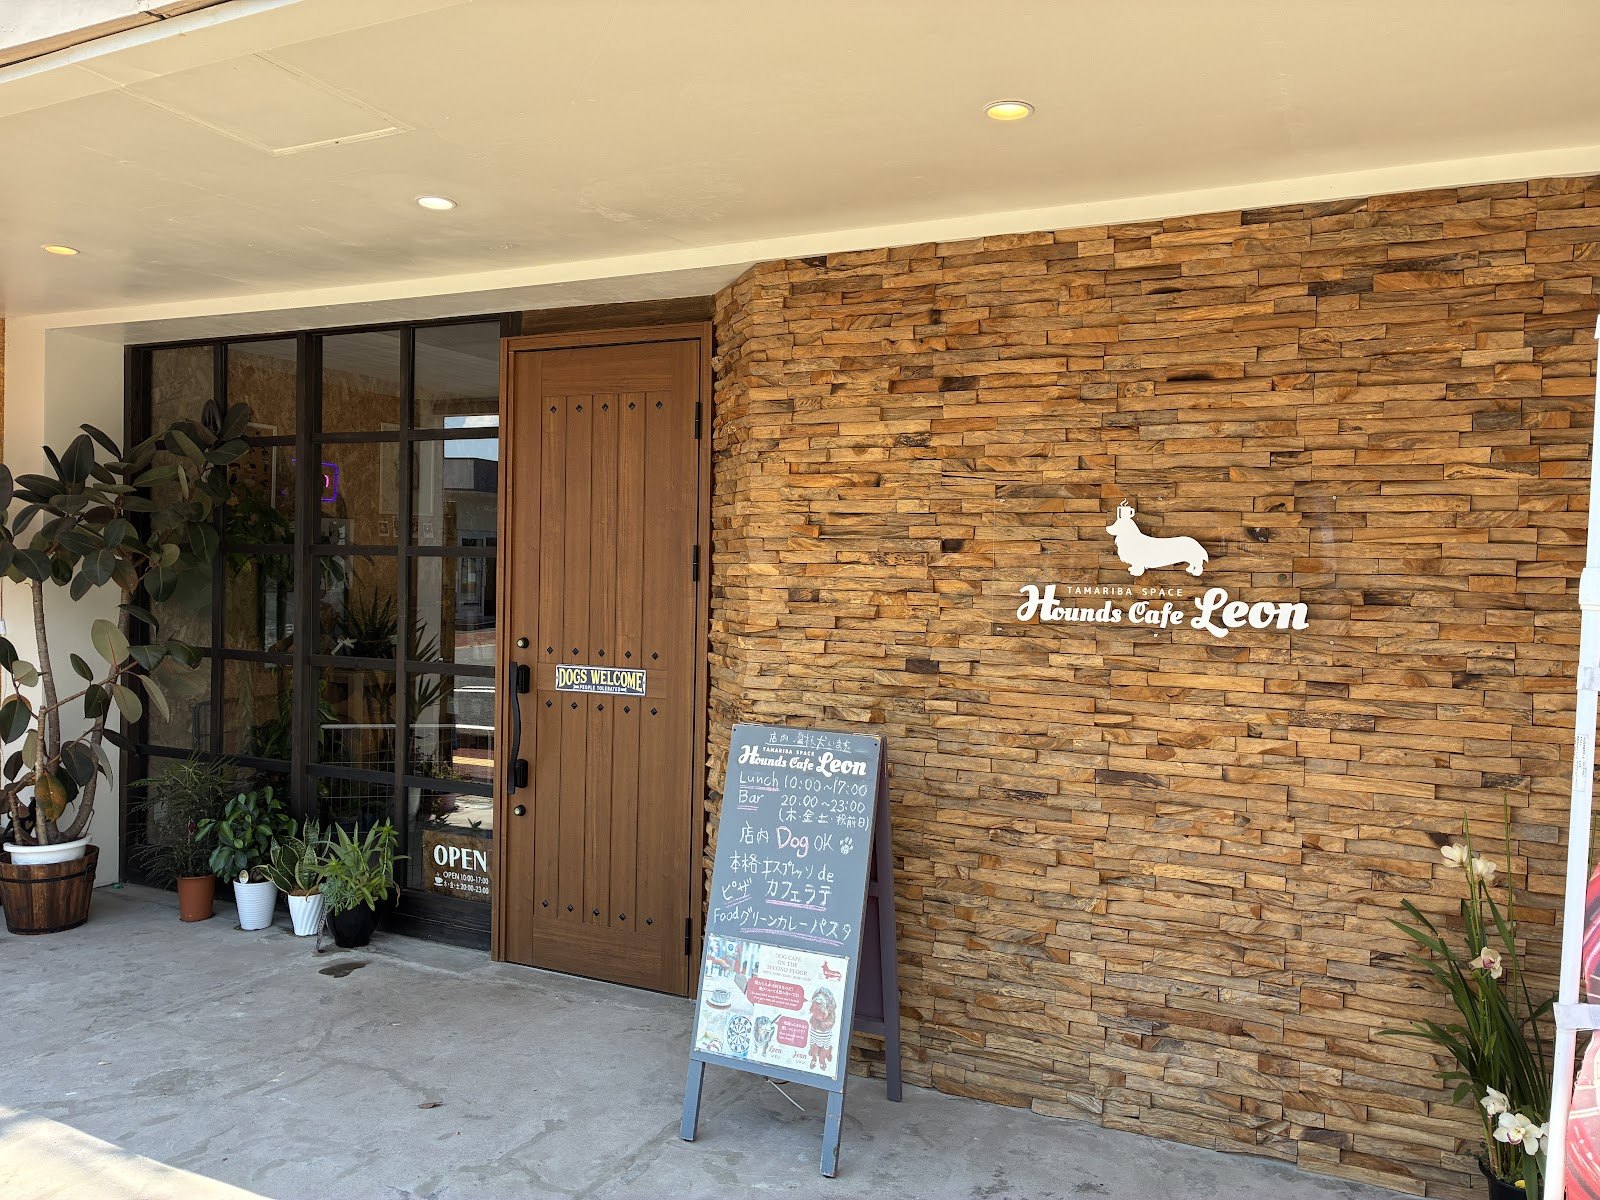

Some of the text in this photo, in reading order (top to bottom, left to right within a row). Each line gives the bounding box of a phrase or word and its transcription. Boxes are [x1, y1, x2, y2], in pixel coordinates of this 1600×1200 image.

[1066, 586, 1184, 597] TAMARIBA SPACE
[1016, 584, 1309, 638] Hounds Cafe Leon
[559, 668, 643, 692] DOGS WELCOME
[768, 731, 789, 743] 店内
[762, 746, 815, 757] TAMARIBA SPACE
[738, 745, 867, 777] Hounds Cafe Leon
[739, 771, 779, 787] Lunch
[738, 789, 764, 803] Bar
[739, 820, 834, 858] 店内 Dog OK
[433, 844, 487, 872] OPEN
[443, 871, 489, 884] OPEN 10:00-17:00
[817, 864, 834, 883] de
[460, 883, 489, 894] 20:00-23:00
[721, 877, 832, 906] ピザ カフェラテ
[713, 906, 739, 923] Food
[789, 968, 808, 976] FLOOR
